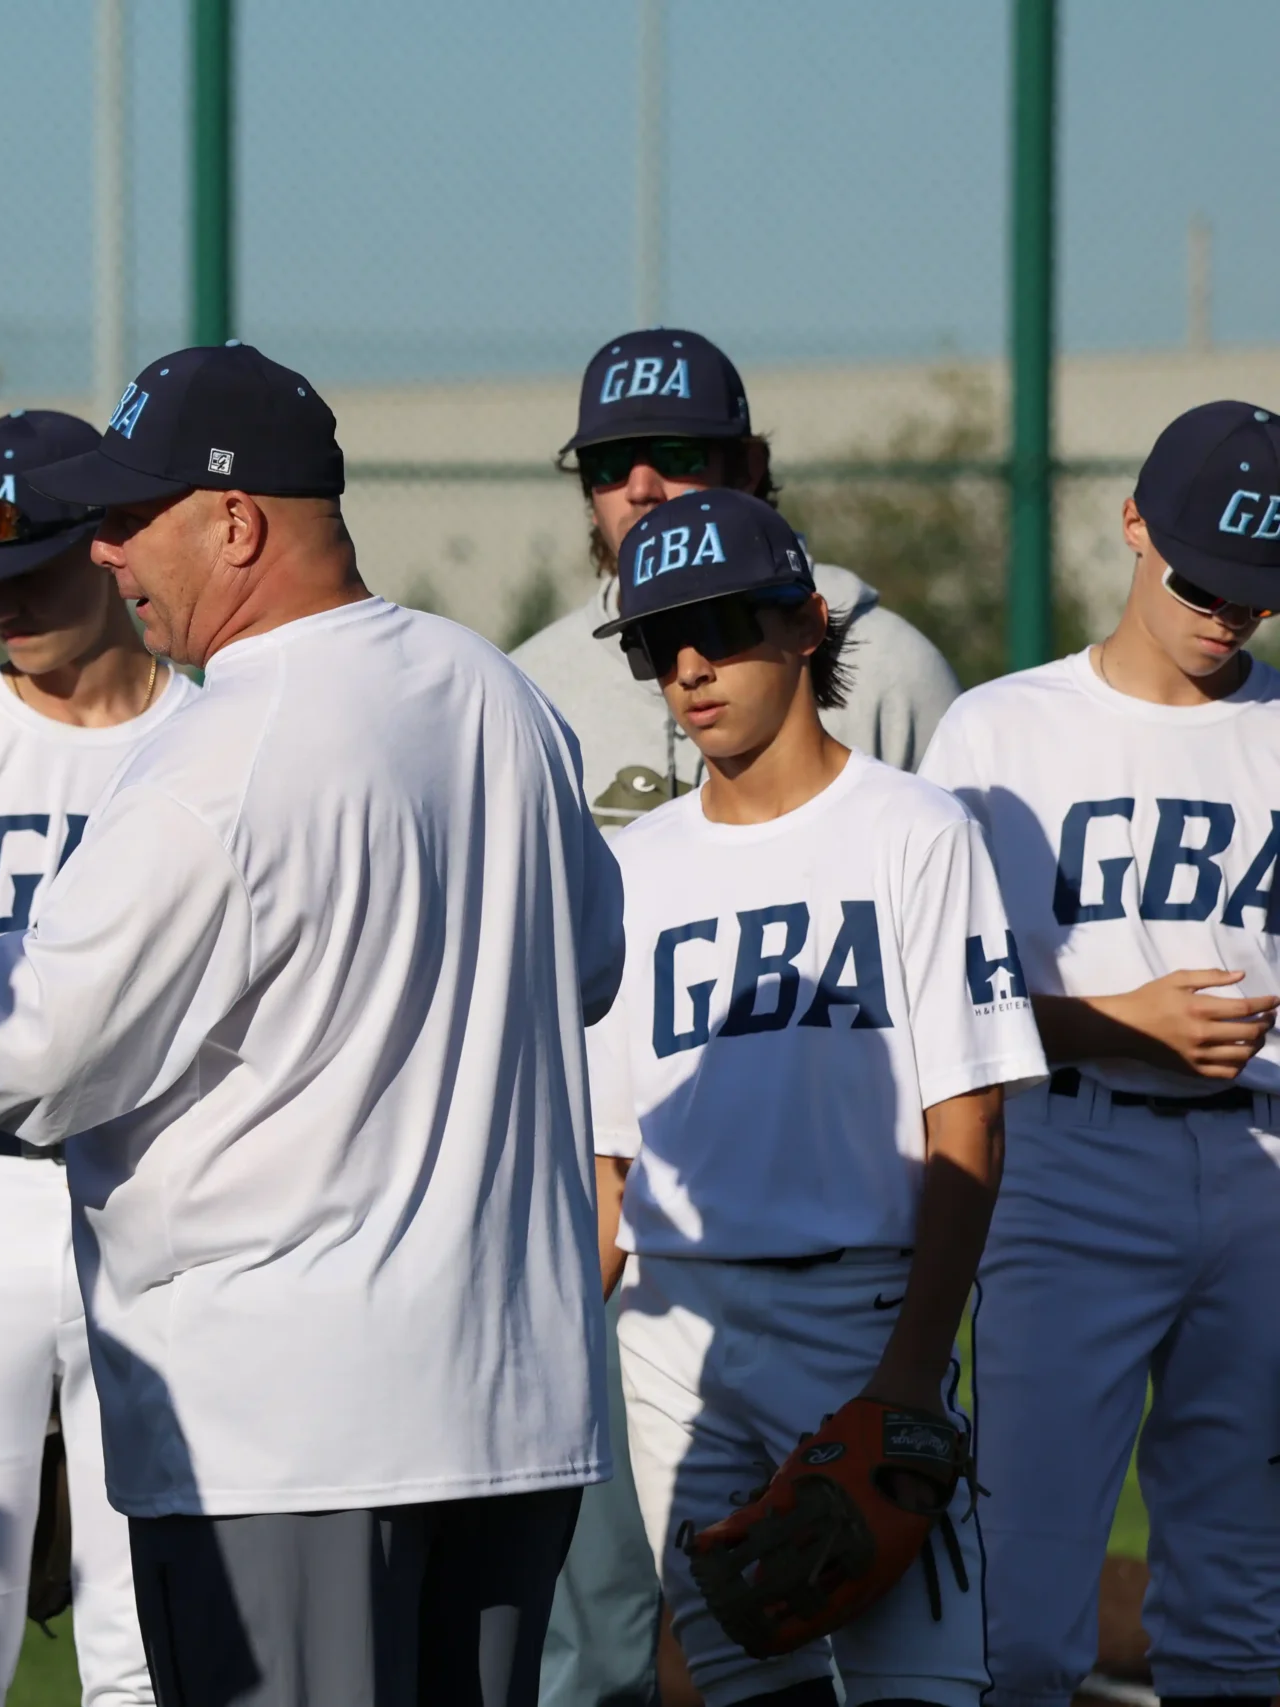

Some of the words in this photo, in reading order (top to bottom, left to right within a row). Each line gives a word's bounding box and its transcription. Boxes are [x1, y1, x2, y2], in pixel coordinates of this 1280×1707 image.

[600, 356, 692, 405] GBA
[632, 521, 727, 588] GBA
[651, 900, 895, 1060] GBA
